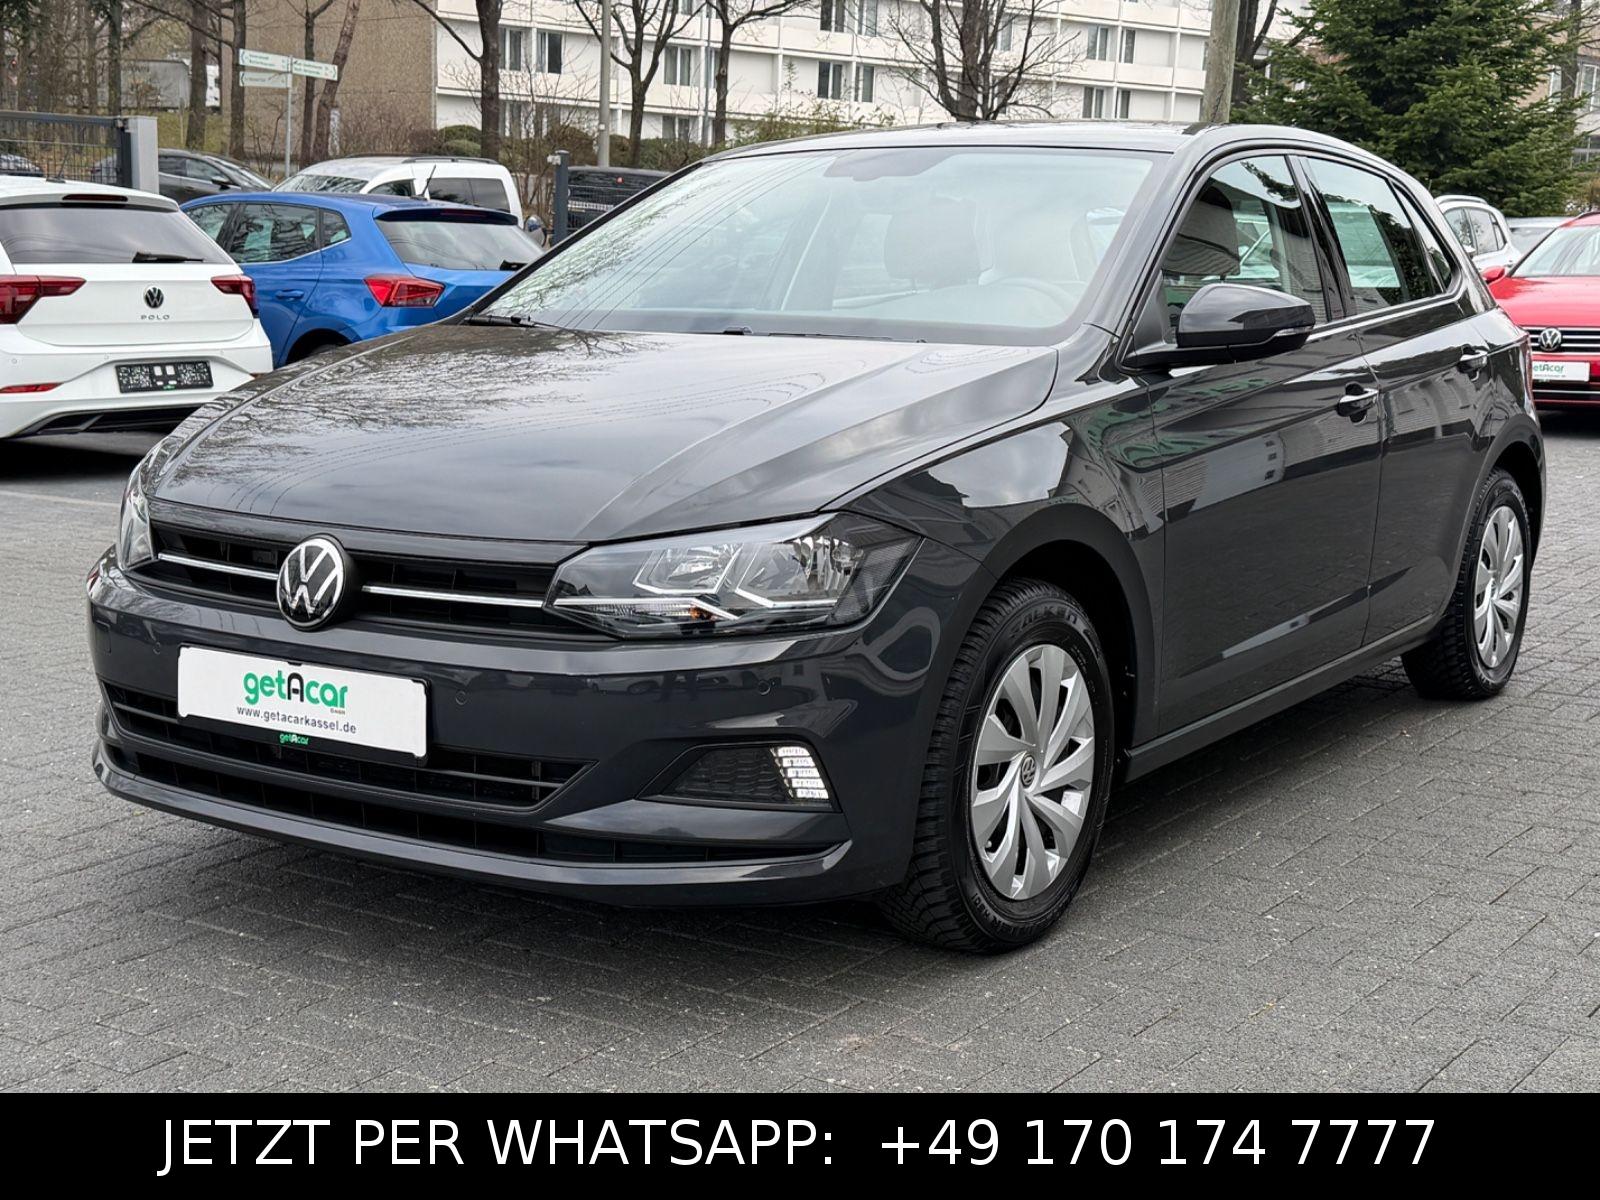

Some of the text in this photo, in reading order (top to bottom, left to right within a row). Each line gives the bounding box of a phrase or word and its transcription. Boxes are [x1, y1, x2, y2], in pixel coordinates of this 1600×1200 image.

[1533, 364, 1564, 373] etAcar
[243, 670, 349, 709] getAcar
[236, 706, 357, 734] www.getacarkassel.de
